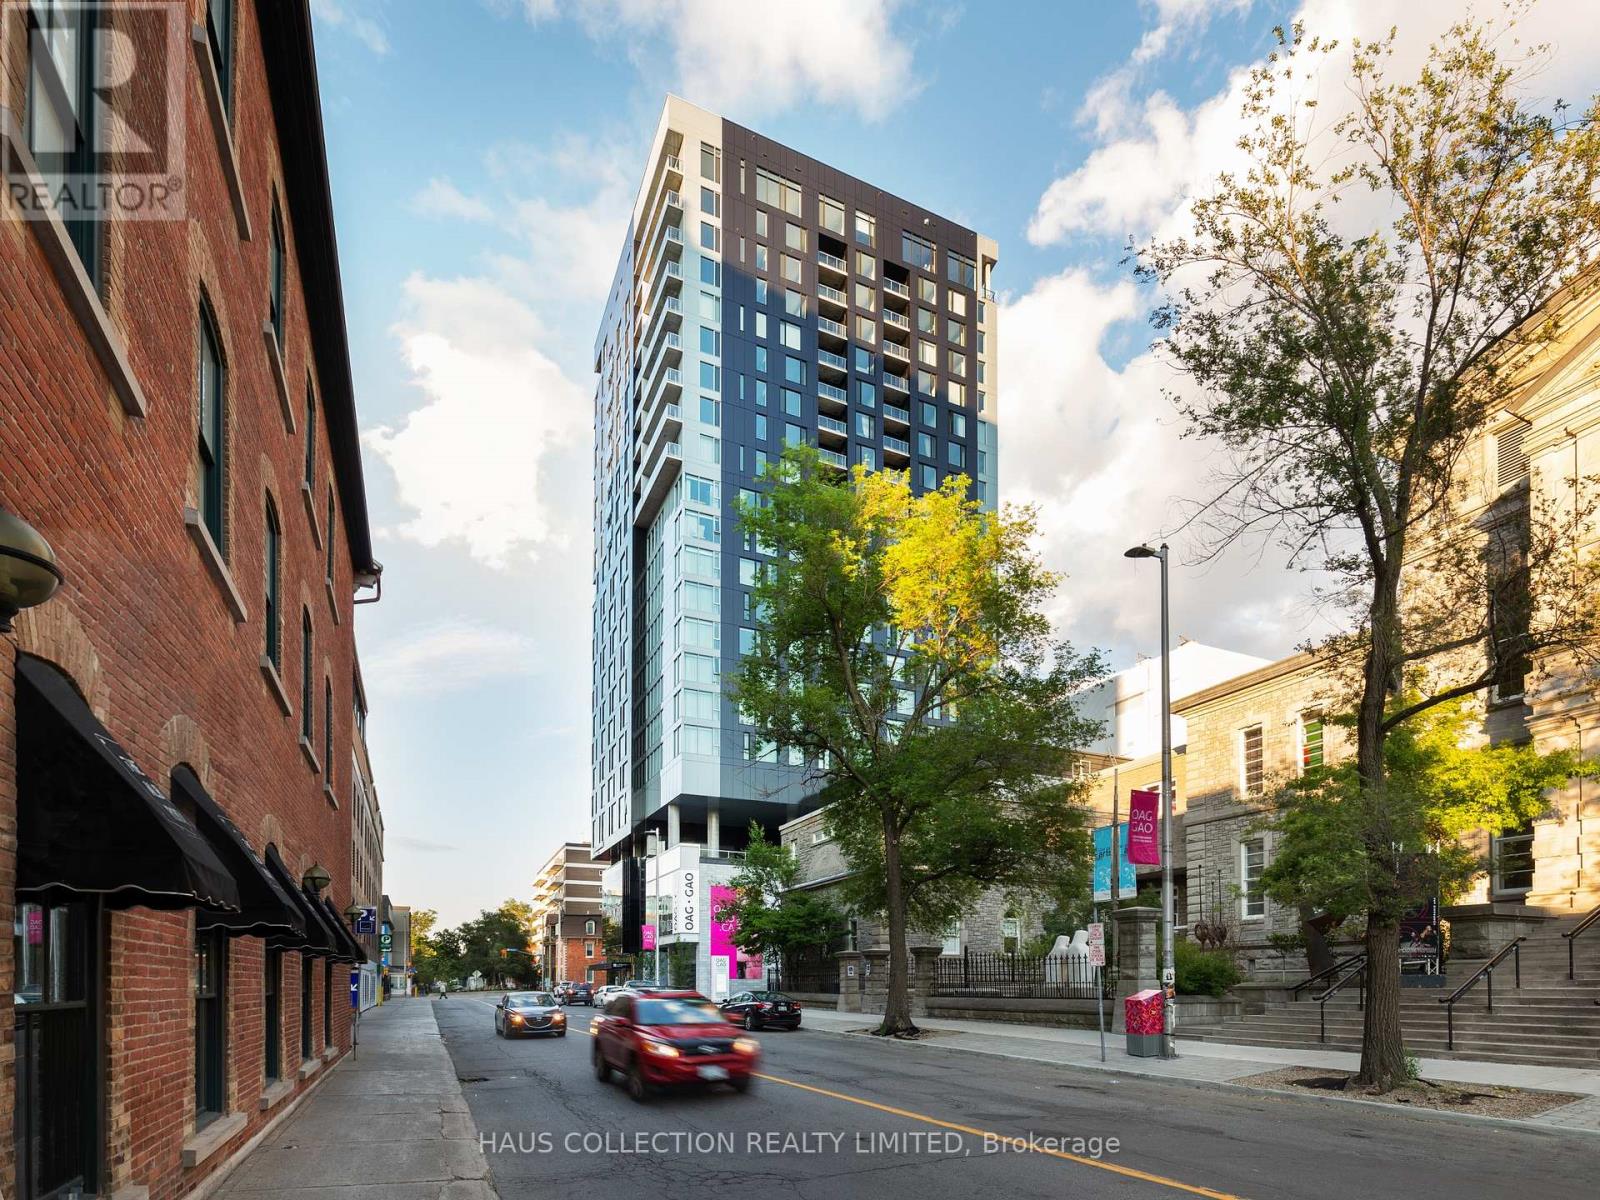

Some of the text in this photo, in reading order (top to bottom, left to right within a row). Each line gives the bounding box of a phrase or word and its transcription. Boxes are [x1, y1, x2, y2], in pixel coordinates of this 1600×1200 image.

[1131, 809, 1153, 821] OAG
[684, 872, 694, 931] OAG GAO
